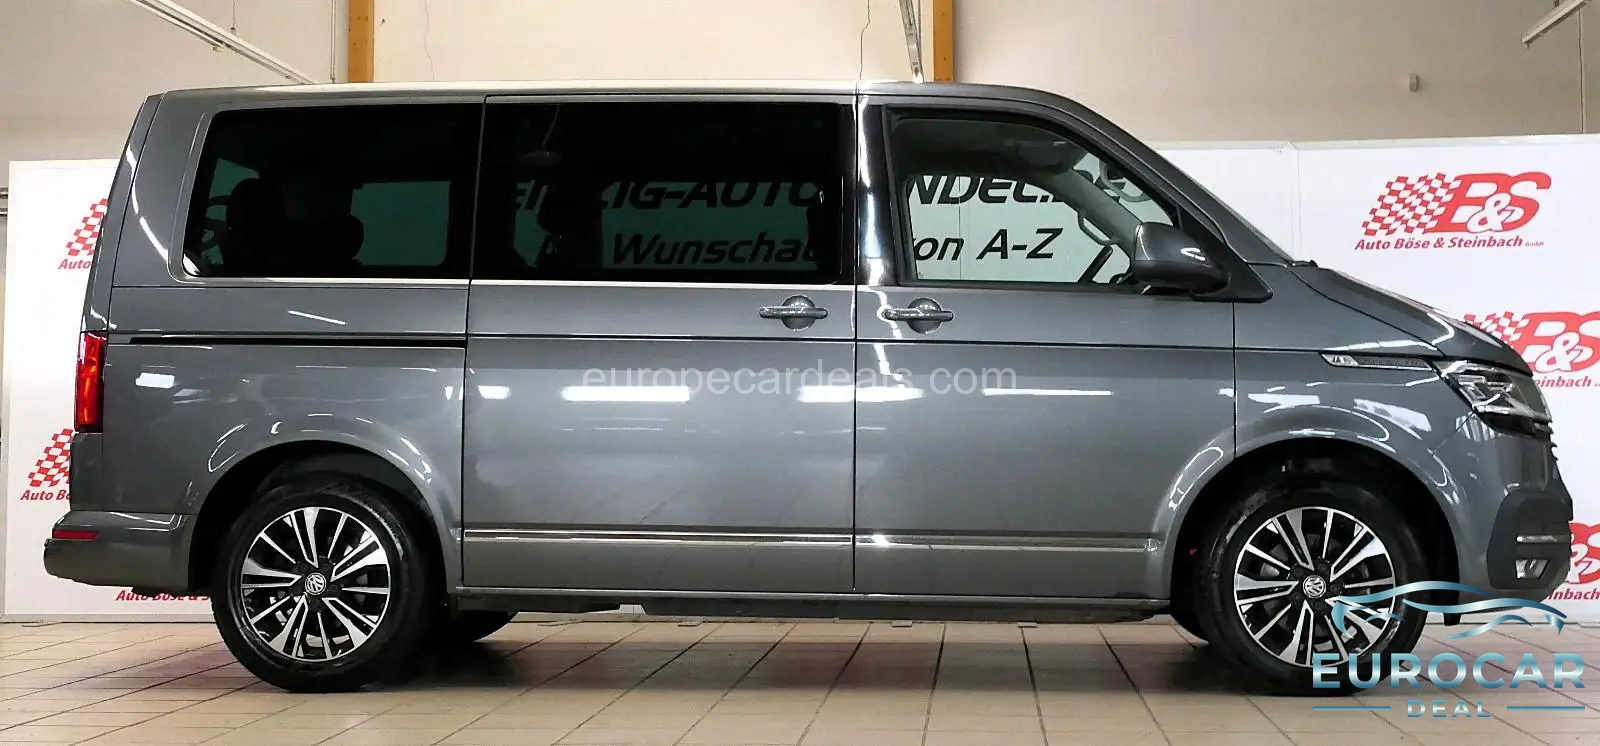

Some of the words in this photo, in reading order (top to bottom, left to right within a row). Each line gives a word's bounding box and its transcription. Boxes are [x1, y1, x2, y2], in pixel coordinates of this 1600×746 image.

[1423, 171, 1552, 234] B&S
[911, 237, 964, 261] on
[976, 228, 1064, 260] A-Z
[1354, 238, 1391, 250] Auto
[1393, 237, 1430, 249] Böse
[1432, 236, 1444, 248] &
[1447, 235, 1523, 248] Steinbach
[57, 258, 92, 270] Auto
[20, 489, 54, 501] Auto
